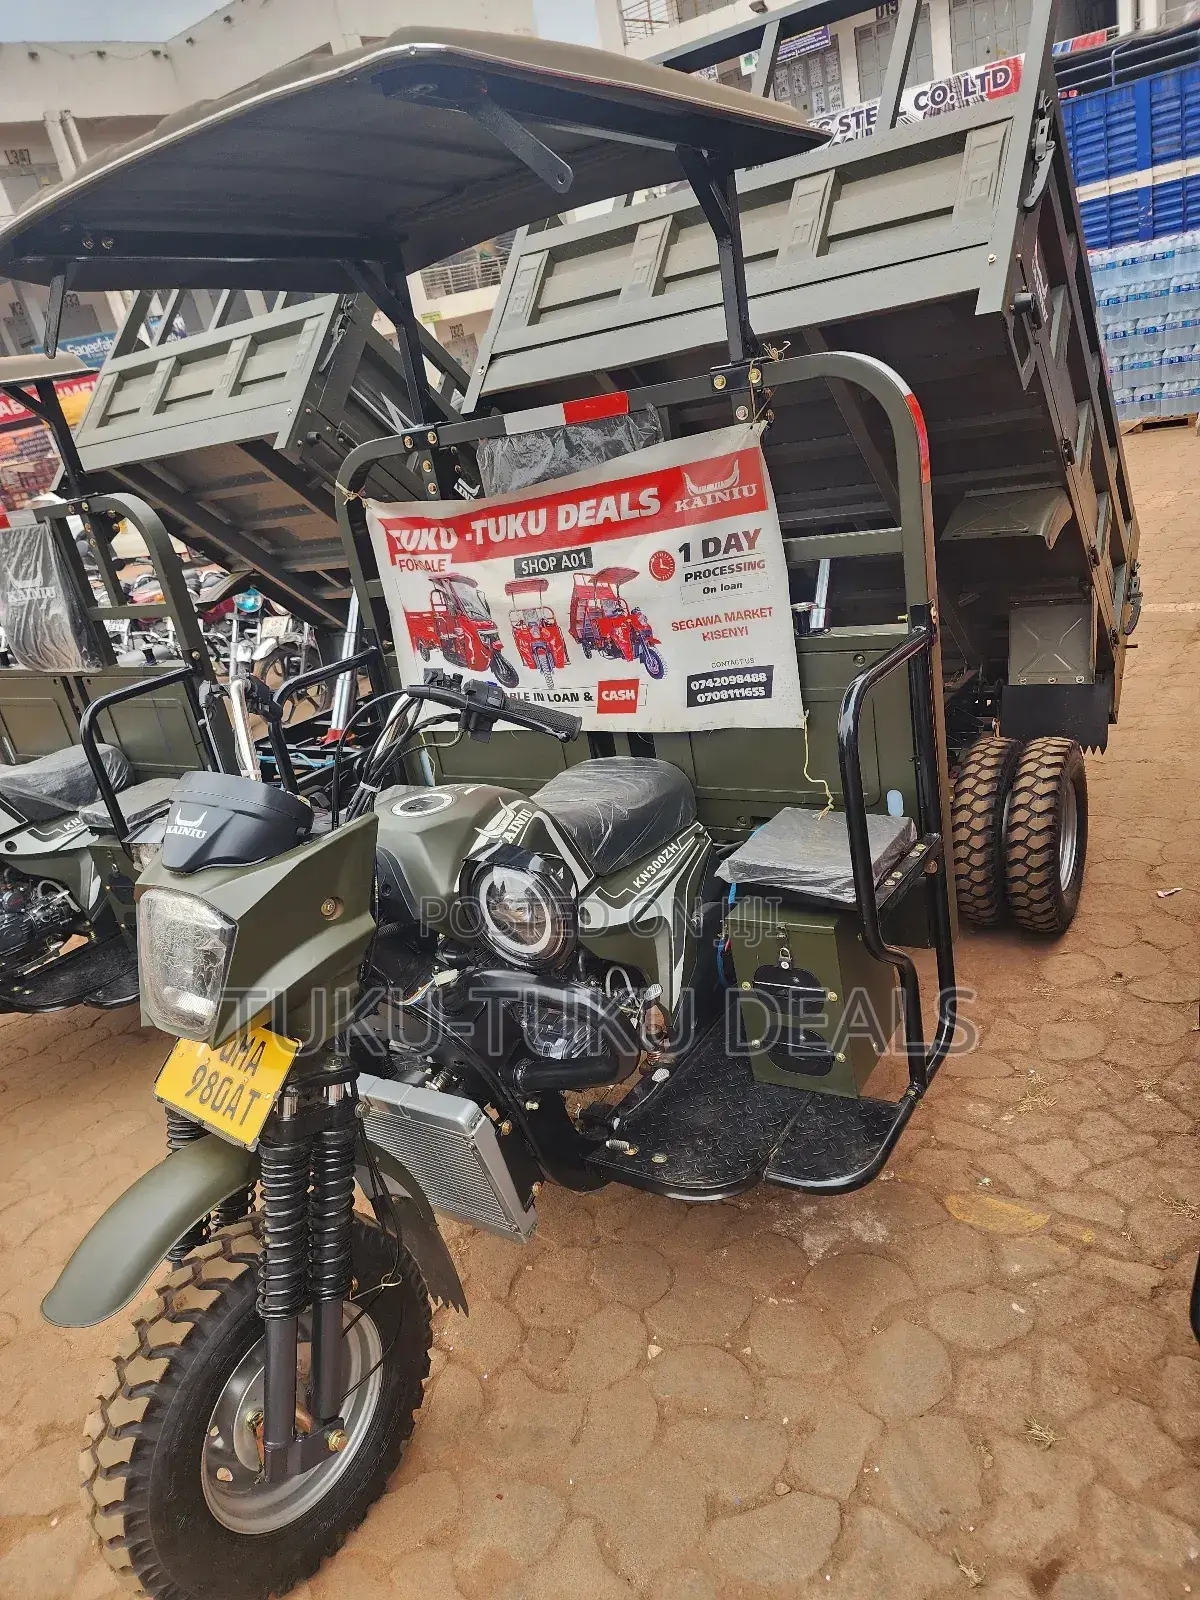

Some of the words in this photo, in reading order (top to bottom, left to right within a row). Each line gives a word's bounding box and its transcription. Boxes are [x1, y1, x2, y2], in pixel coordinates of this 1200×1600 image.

[914, 84, 956, 111] CO.
[963, 66, 1012, 99] LTD
[674, 484, 758, 513] KAINIU
[388, 527, 458, 551] TUKU
[557, 487, 661, 532] DEALS
[678, 542, 691, 562] 1
[702, 528, 762, 559] DAY
[521, 557, 557, 575] SHOP
[561, 552, 587, 570] A01
[684, 559, 766, 582] PROCESSING
[702, 586, 717, 595] On
[720, 582, 743, 592] loan
[671, 614, 722, 632] SEGAWA
[724, 606, 773, 622] MARKET
[702, 626, 749, 642] KISENYI
[711, 659, 744, 669] CONTACT
[690, 672, 768, 691] 0742098488
[503, 692, 531, 702] ABLE
[533, 692, 545, 702] IN
[548, 692, 580, 703] LOAN
[583, 691, 594, 702] &
[601, 689, 636, 701] CASH
[166, 825, 208, 839] KAINIU
[503, 808, 534, 845] AINIU
[632, 842, 680, 889] KN300ZH
[184, 1064, 262, 1126] 980AT
